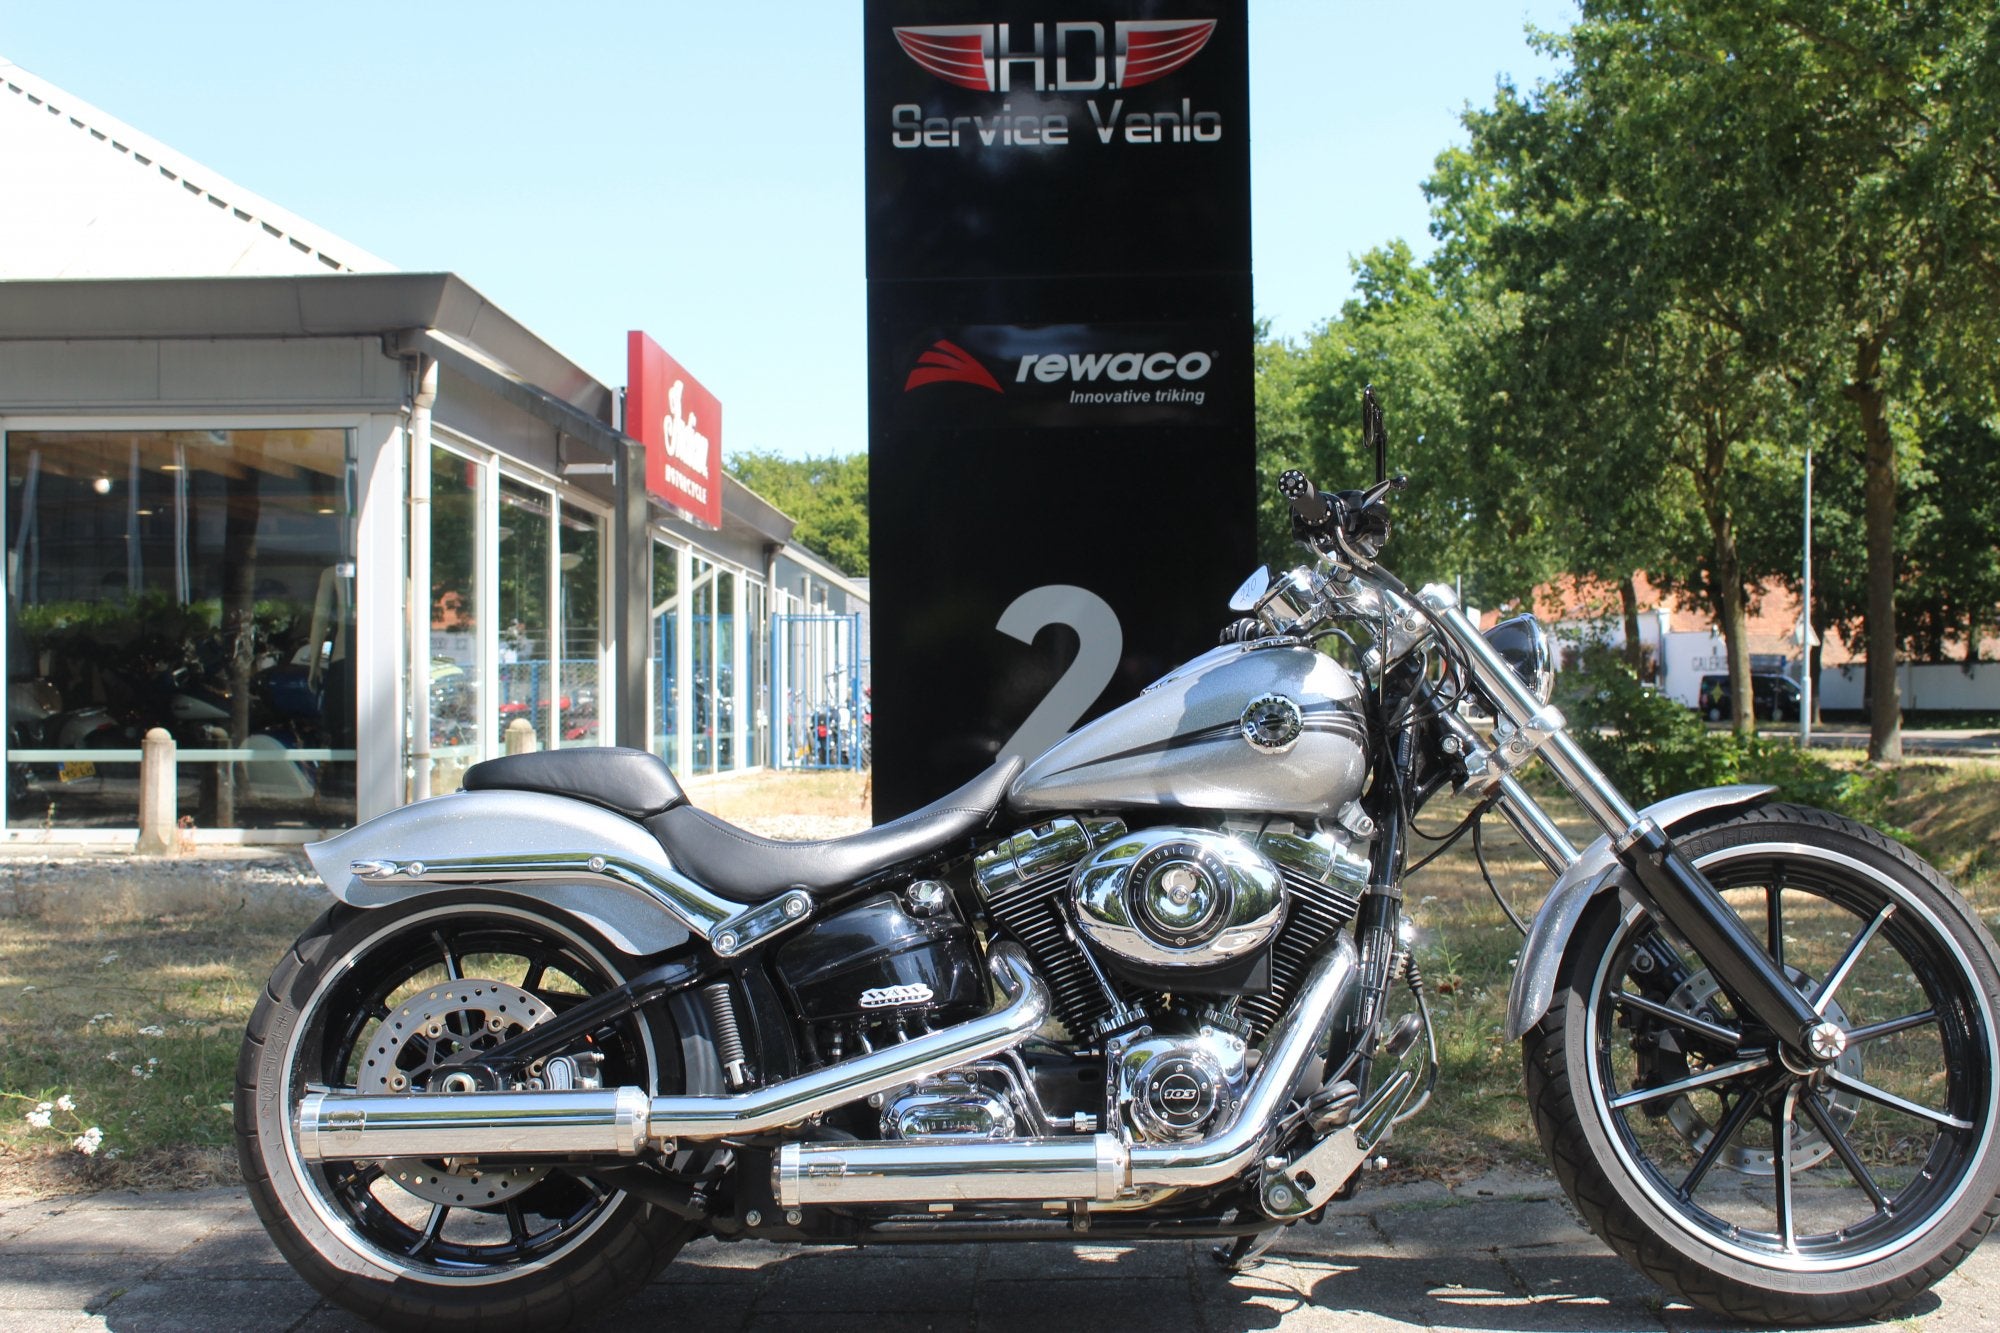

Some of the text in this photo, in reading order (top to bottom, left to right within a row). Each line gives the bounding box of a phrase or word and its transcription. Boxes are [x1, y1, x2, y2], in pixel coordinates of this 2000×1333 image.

[892, 98, 1222, 148] Service Venlo
[1015, 351, 1212, 383] rewaco
[1069, 389, 1205, 405] Innovative triking
[995, 584, 1123, 768] 2
[1148, 847, 1184, 864] CUBIC
[1164, 1089, 1196, 1100] 103
